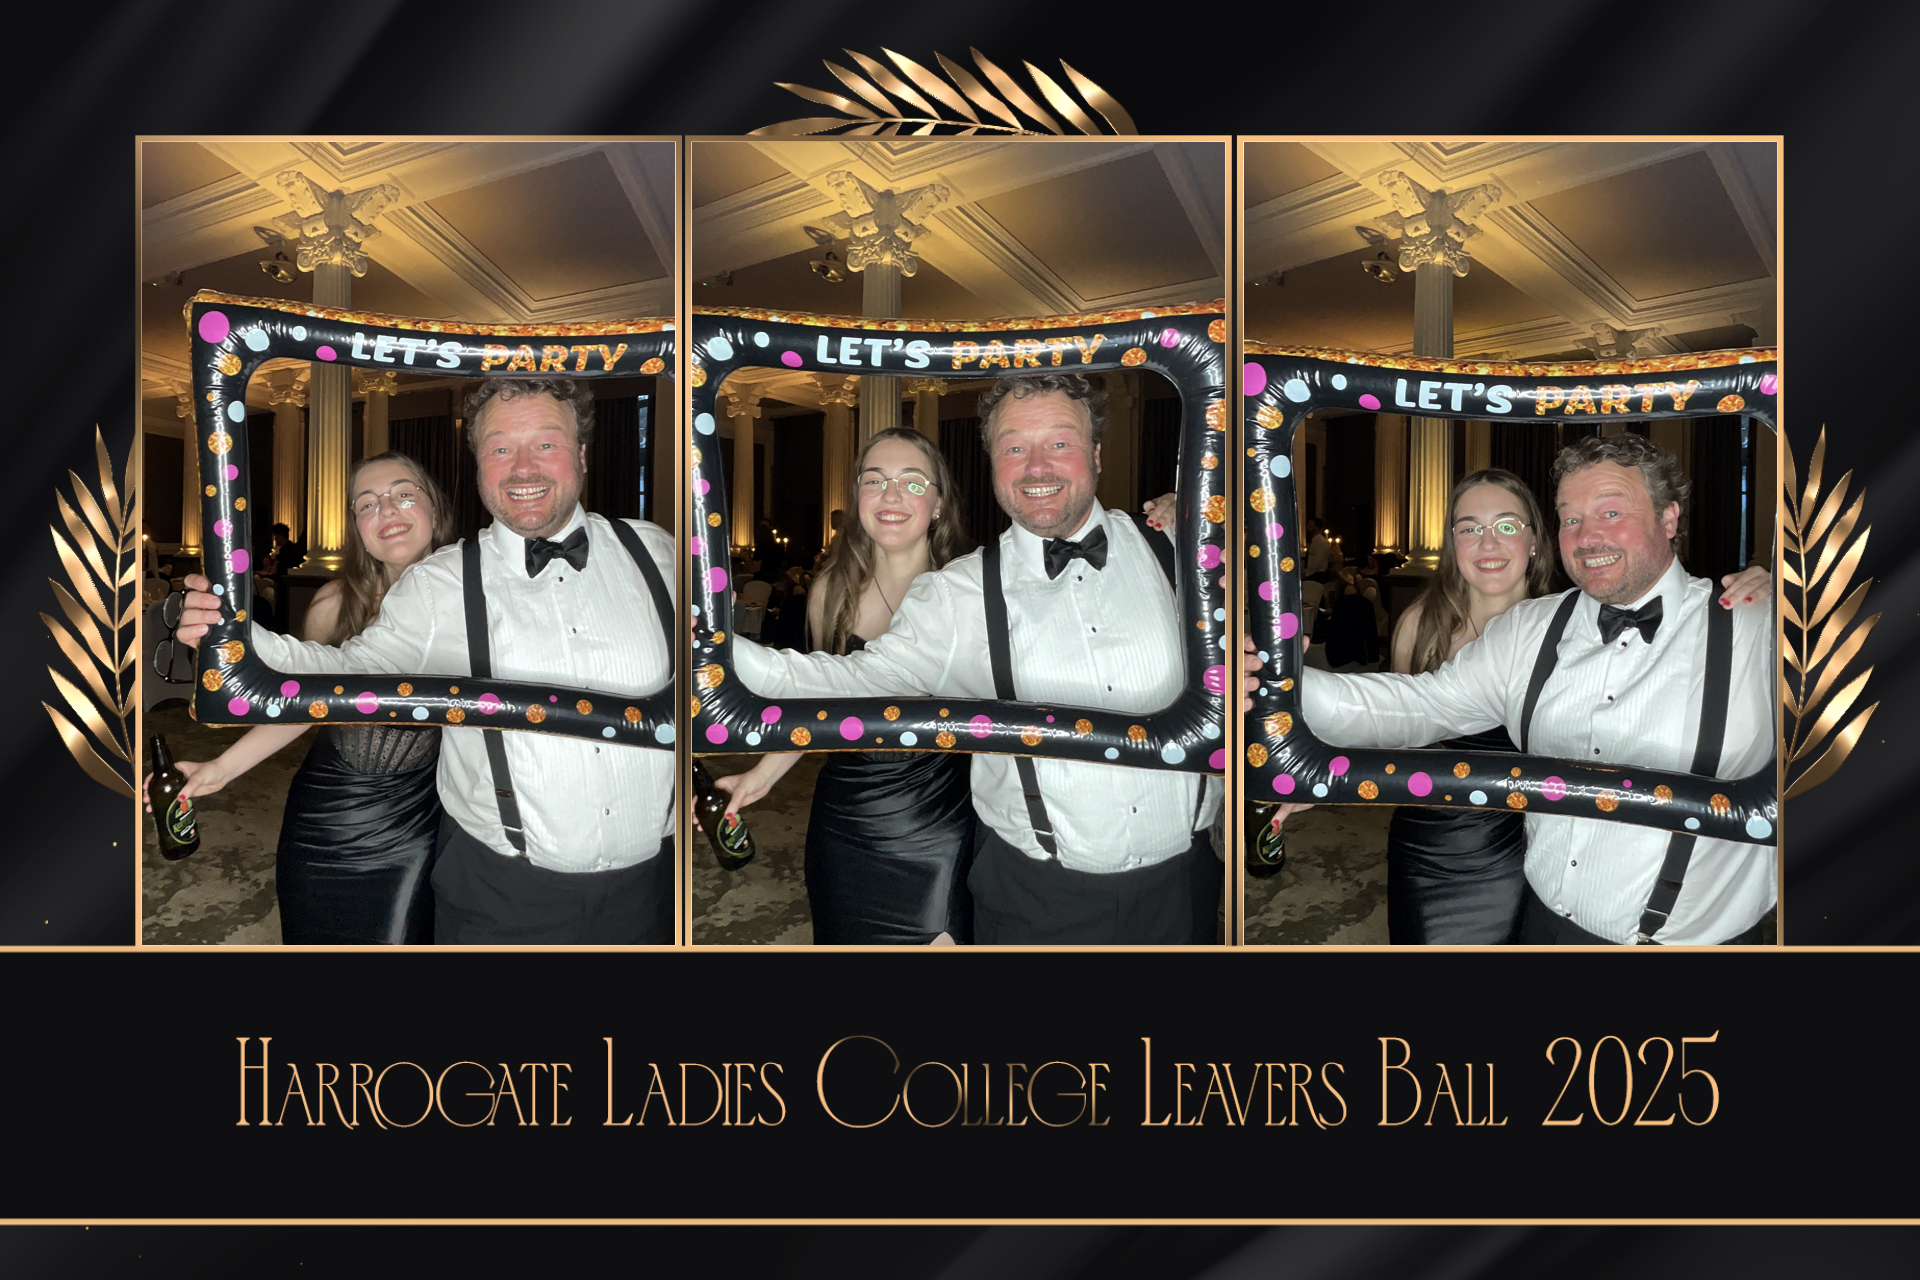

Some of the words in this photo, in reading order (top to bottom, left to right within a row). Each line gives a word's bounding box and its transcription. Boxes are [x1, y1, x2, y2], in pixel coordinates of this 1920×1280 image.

[350, 332, 462, 369] LET'S
[480, 343, 628, 372] PARTY
[816, 334, 931, 369] LET'S
[951, 333, 1106, 370] PARTY
[1394, 378, 1513, 414] LET'S
[1535, 379, 1699, 416] PARTY
